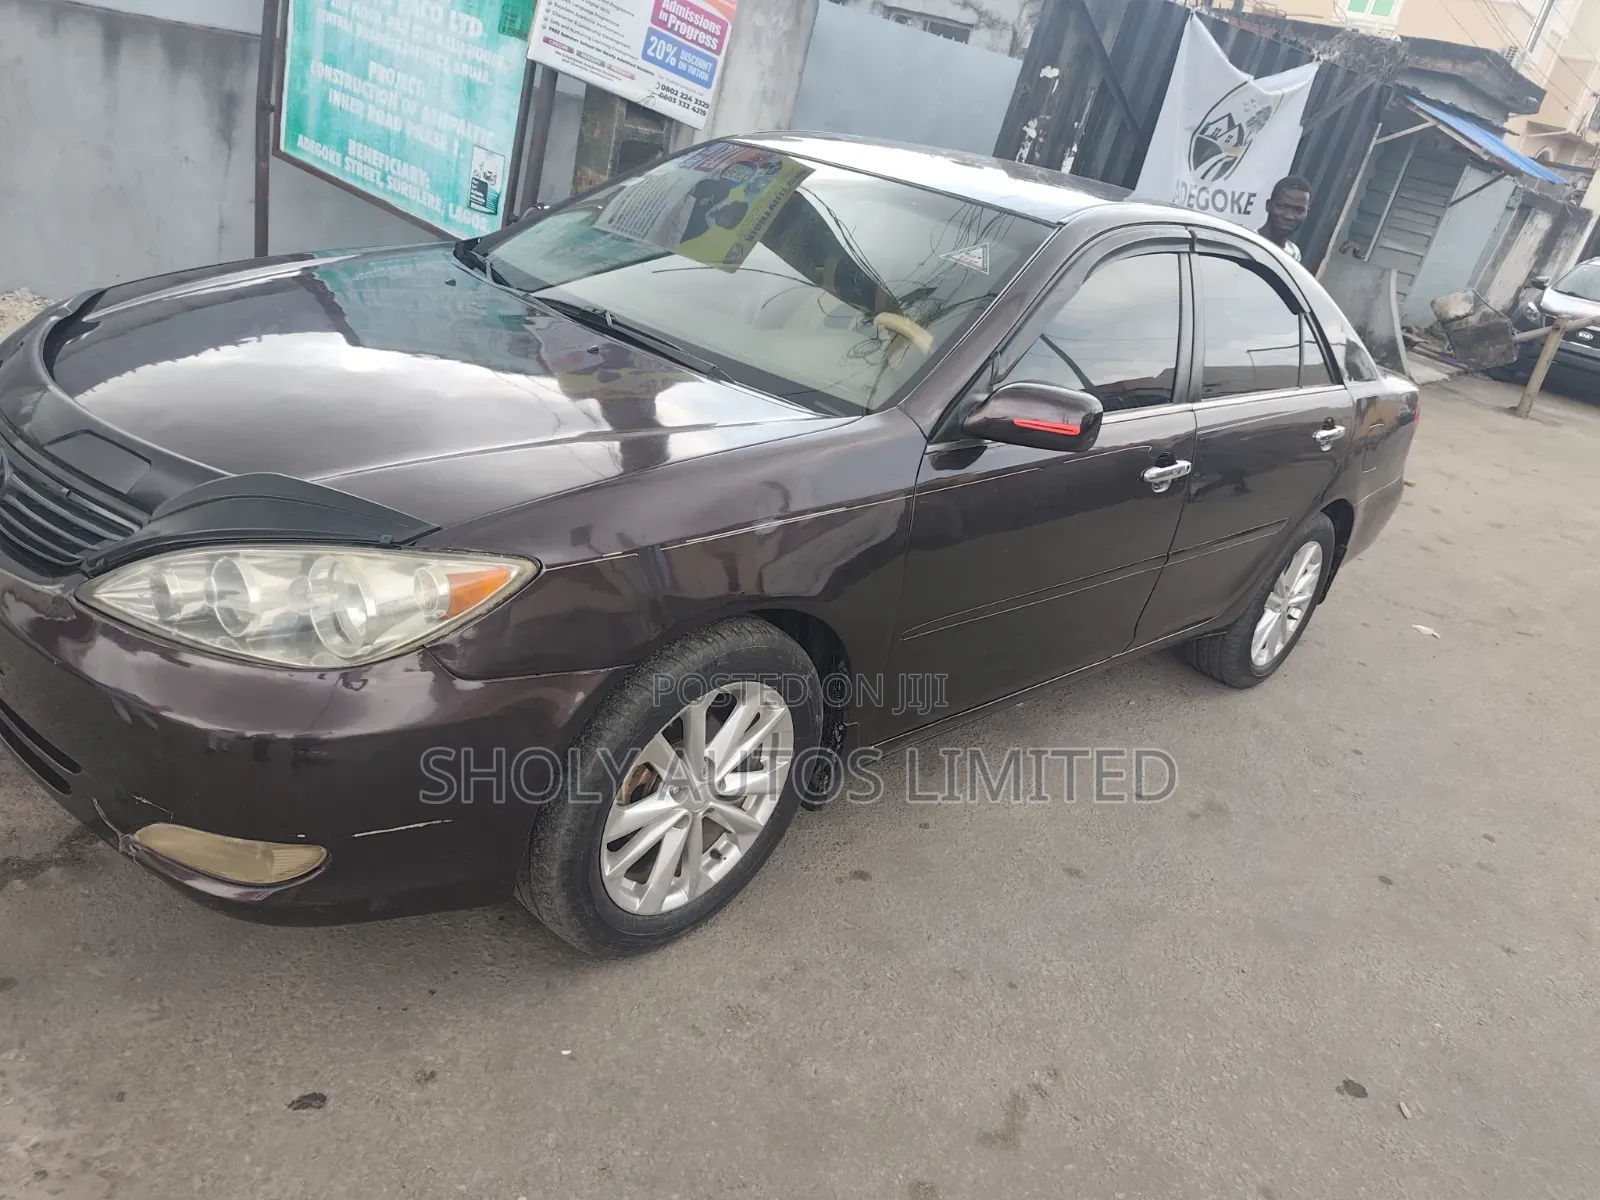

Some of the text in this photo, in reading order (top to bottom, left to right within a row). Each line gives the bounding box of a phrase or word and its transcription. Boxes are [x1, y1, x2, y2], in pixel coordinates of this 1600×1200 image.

[450, 8, 483, 37] LTD
[659, 10, 719, 51] in Progress
[661, 0, 722, 36] Admissions
[647, 36, 678, 67] 20%
[678, 60, 687, 72] ON
[680, 50, 715, 73] DISCOUNT
[311, 60, 398, 113] CONSTRUCTION
[369, 60, 425, 98] PROJECT:
[661, 84, 710, 110] 0802 224 3329
[328, 87, 364, 117] INNER
[368, 104, 402, 131] ROAD
[659, 92, 677, 105] 0803
[678, 100, 691, 110] 332
[297, 133, 342, 169] ADEGOKE
[344, 156, 384, 189] STREET,
[387, 174, 446, 217] SURULERE,
[348, 138, 430, 190] BENEFICIARY:
[1172, 179, 1258, 216] ADEGOKE
